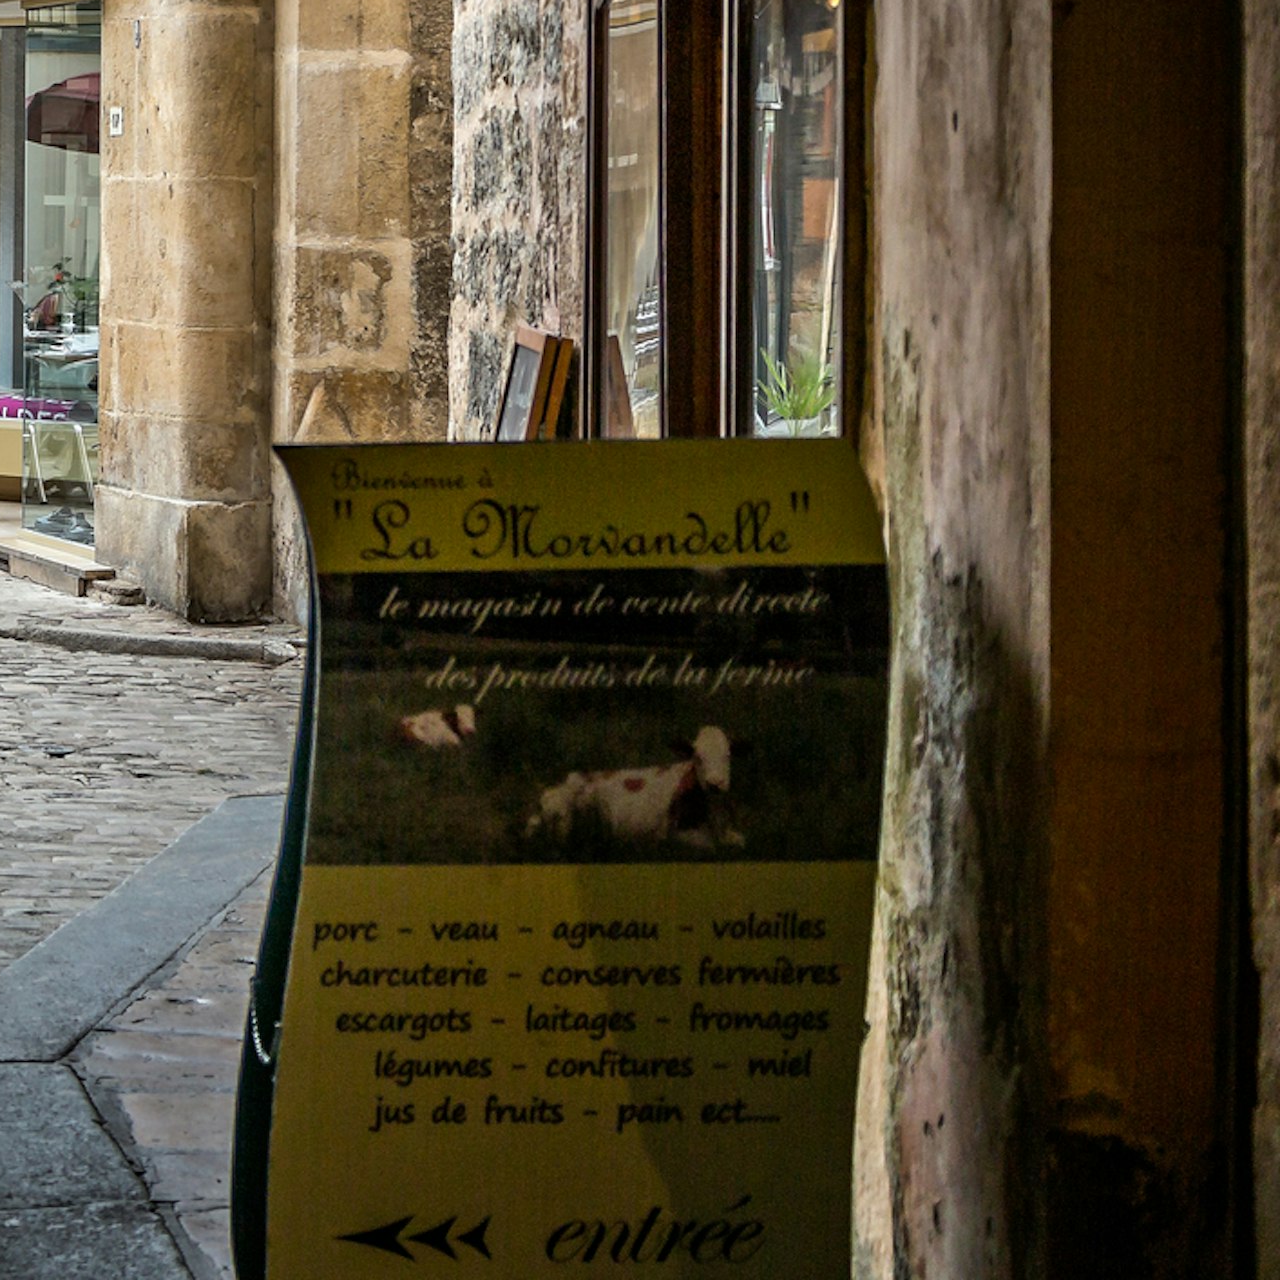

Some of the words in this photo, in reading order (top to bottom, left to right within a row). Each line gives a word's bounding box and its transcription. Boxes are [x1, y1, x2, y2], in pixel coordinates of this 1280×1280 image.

[333, 459, 464, 491] Bienvenue
[478, 467, 494, 488] à
[380, 586, 409, 618] le
[418, 592, 562, 634] magasin
[572, 583, 615, 616] de
[622, 590, 710, 615] vente
[717, 580, 831, 614] directe
[426, 656, 477, 689] des
[474, 656, 617, 705] produits
[626, 654, 667, 687] de
[707, 657, 814, 695] ferme
[313, 920, 378, 951] porc
[431, 922, 498, 941] veau
[552, 921, 660, 948] agneau
[712, 912, 826, 940] volailles
[320, 960, 488, 987] charcuterie
[541, 965, 682, 987] conserves
[336, 1008, 472, 1041] escargots
[525, 1004, 637, 1040] laitages
[690, 1002, 830, 1040] fromages
[374, 1050, 493, 1087] légumes
[545, 1049, 694, 1078] confitures
[747, 1050, 812, 1077] miel
[368, 1097, 415, 1132] jus
[431, 1096, 467, 1124] de
[484, 1095, 565, 1124] fruits
[615, 1097, 683, 1134] pain
[545, 1194, 766, 1264] entrée
